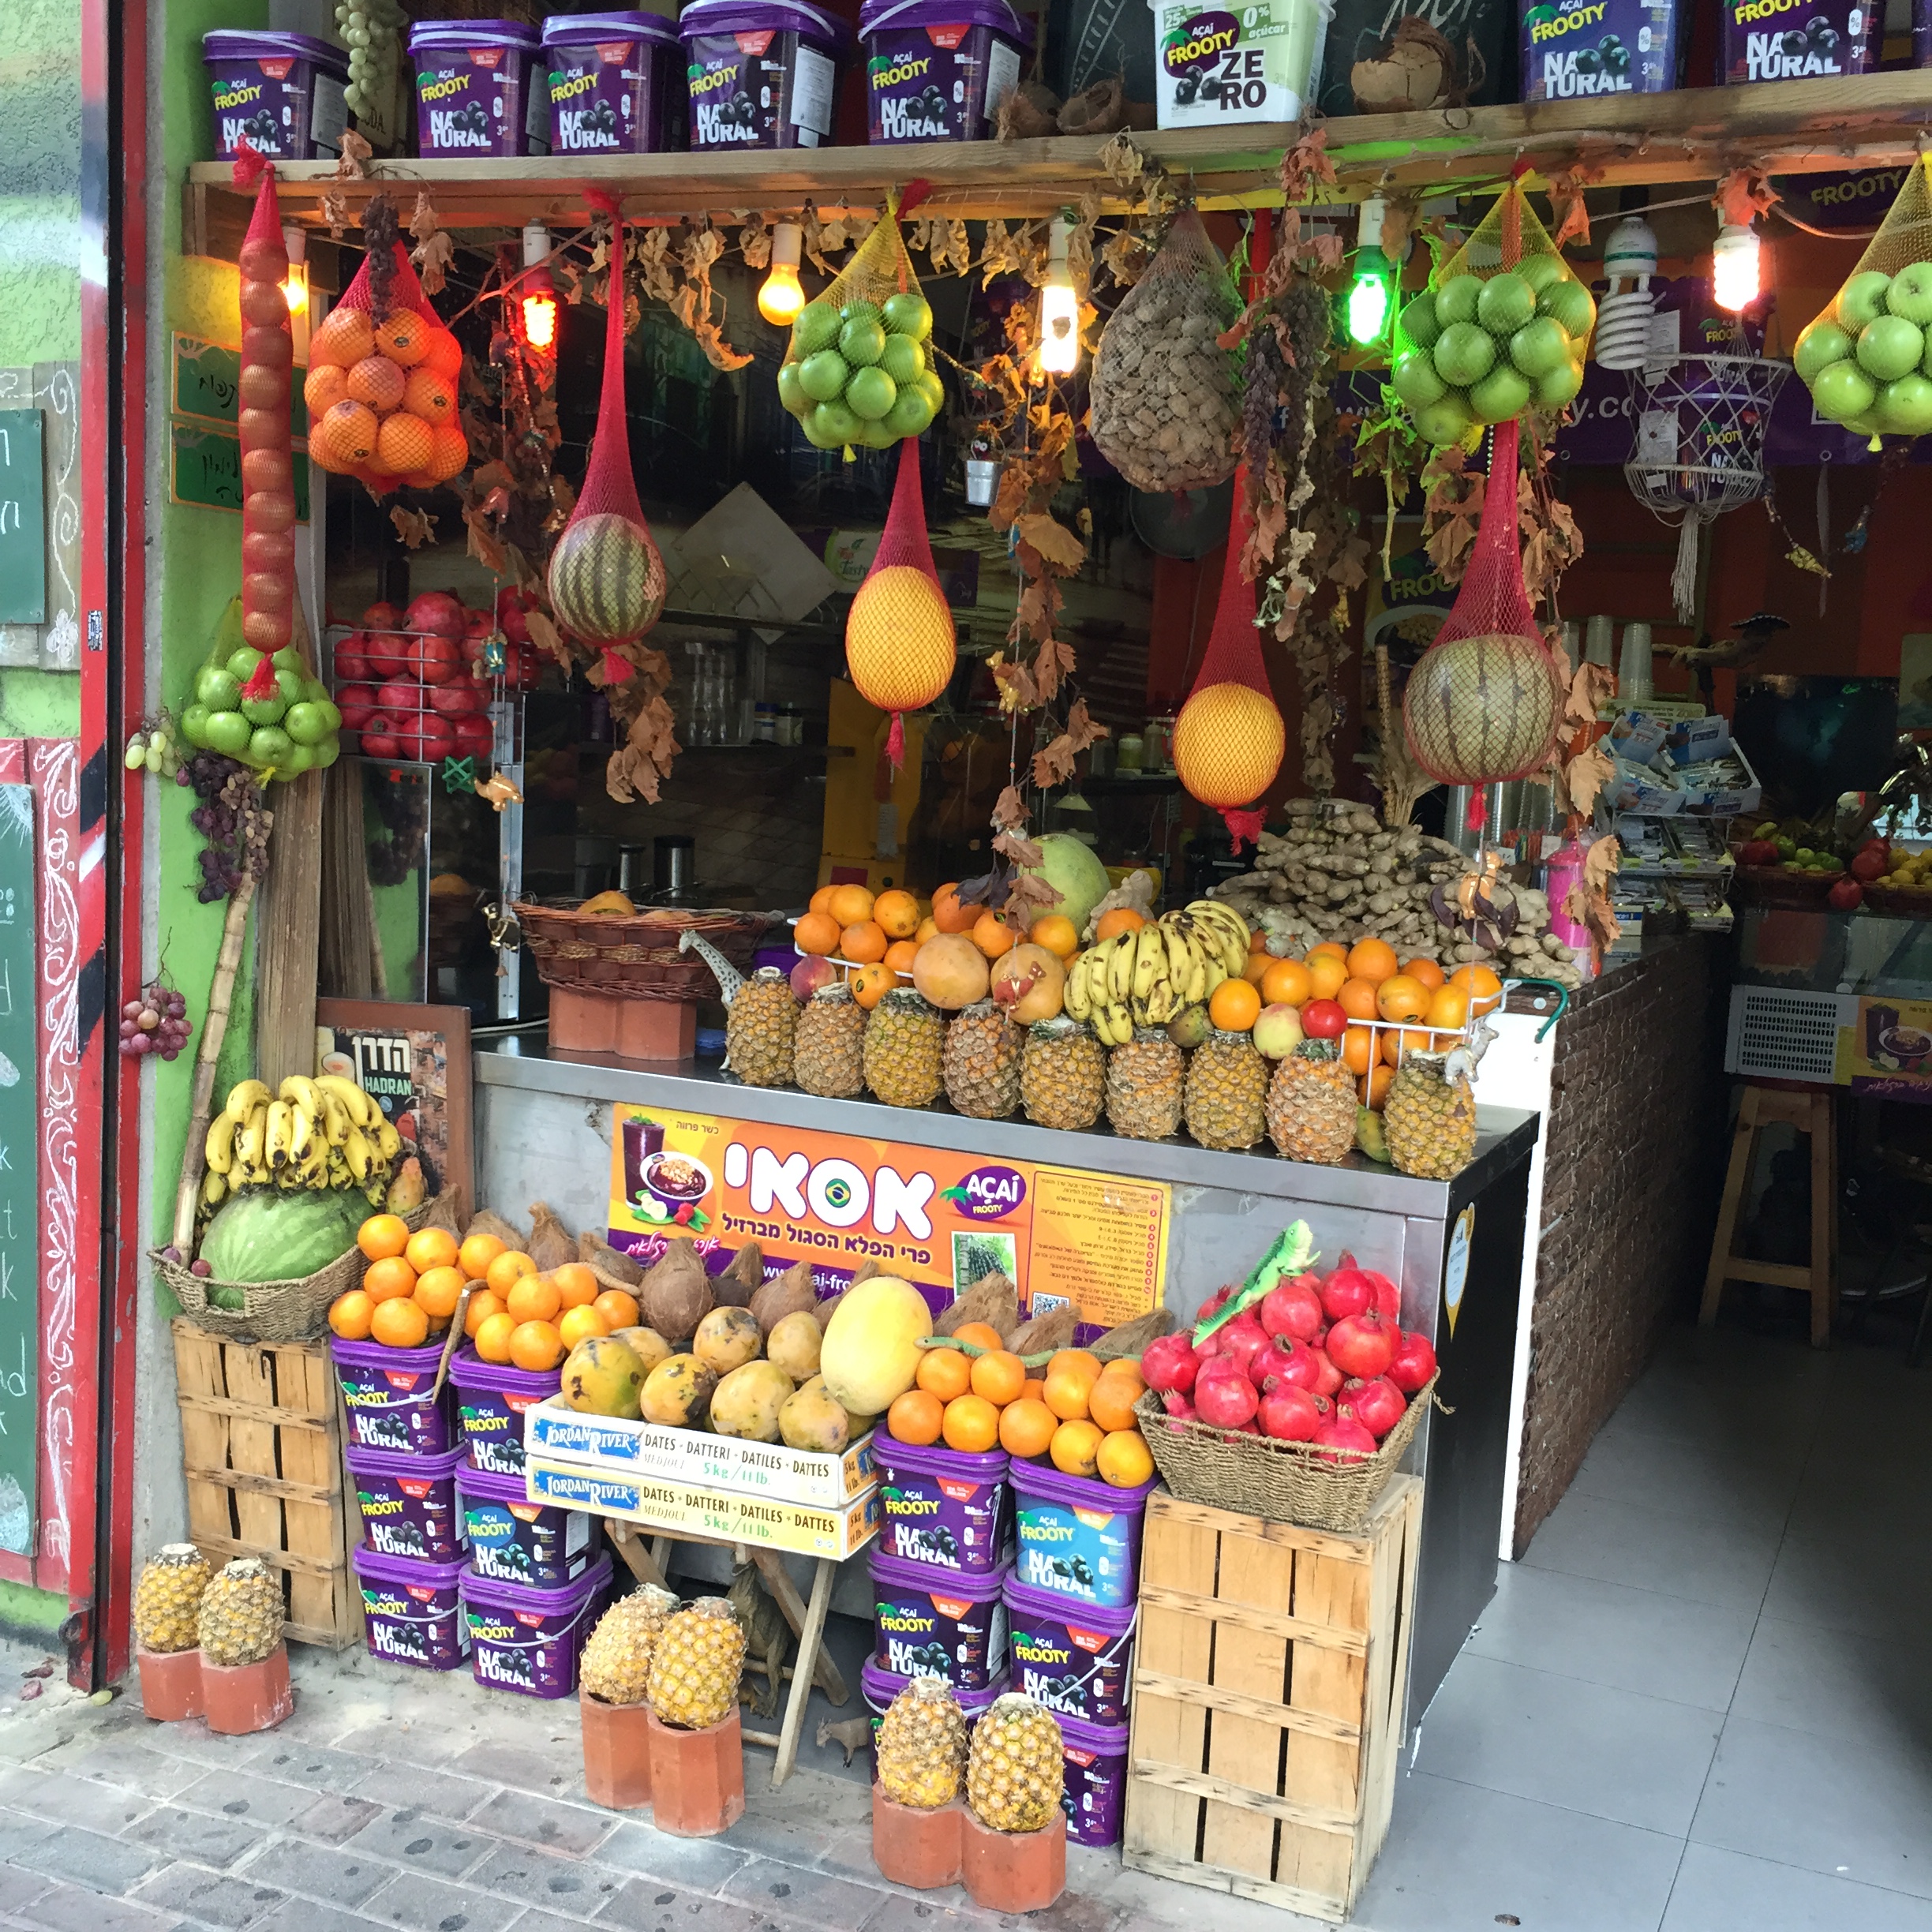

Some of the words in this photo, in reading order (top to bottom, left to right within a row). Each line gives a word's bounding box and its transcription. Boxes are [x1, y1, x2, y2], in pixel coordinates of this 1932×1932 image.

[1192, 22, 1214, 38] AÇAÍ
[1249, 24, 1286, 39] açúcar
[1531, 2, 1607, 43] FROOTY
[893, 51, 912, 65] AÇAÍ
[1167, 29, 1234, 66] FROOTY
[1747, 32, 1784, 63] NA
[438, 69, 455, 79] AÇAÍ
[567, 67, 583, 79] AÇAÍ
[706, 59, 722, 72] AÇAÍ
[872, 58, 930, 90] FROOTY
[1222, 50, 1264, 80] ZE
[1544, 51, 1578, 80] NA
[1749, 54, 1841, 80] TURAL
[231, 78, 247, 91] AÇAÍ
[421, 74, 470, 103] FROOTY
[551, 73, 598, 103] FROOTY
[690, 65, 739, 97] FROOTY
[1544, 73, 1632, 98] TURAL
[215, 85, 261, 110] FROOTY
[1221, 80, 1267, 110] RO
[697, 103, 721, 129] NA
[881, 97, 908, 124] NA
[431, 110, 452, 133] NA
[560, 110, 582, 136] NA
[883, 117, 949, 139] TURAL
[432, 130, 492, 148] TURAL
[560, 130, 620, 149] TURAL
[698, 122, 758, 144] TURAL
[1811, 169, 1904, 205] FROOTY
[352, 1036, 410, 1090] הדרן
[365, 1076, 412, 1095] HADRAN
[676, 1121, 698, 1131] פרווה
[701, 1125, 719, 1135] כשר
[724, 1142, 936, 1241] אסאי
[966, 1174, 1020, 1204] AÇAÍ
[972, 1204, 1003, 1214] FROOTY
[722, 1213, 781, 1238] מברזיל
[787, 1223, 839, 1249] הסגול
[845, 1235, 894, 1258] הפלא
[900, 1246, 930, 1264] פרי
[360, 1383, 374, 1392] AÇAÍ
[346, 1391, 388, 1406] FROOTY
[355, 1413, 378, 1432] NA
[478, 1409, 493, 1417] AÇAÍ
[463, 1417, 508, 1432] FROOTY
[360, 1429, 414, 1451] TURAL
[473, 1439, 494, 1457] NA
[544, 1425, 590, 1447] JORDAN
[589, 1430, 632, 1458] RIVER
[645, 1434, 676, 1451] DATES
[687, 1440, 731, 1461] DATTERI
[742, 1451, 782, 1470] DATILES
[793, 1460, 829, 1477] DATTES
[375, 1493, 389, 1502] AÇAÍ
[545, 1476, 590, 1498] JORDAN
[589, 1482, 632, 1507] RIVER
[904, 1490, 923, 1500] AÇAÍ
[361, 1500, 403, 1515] FROOTY
[643, 1486, 675, 1503] DATES
[686, 1494, 729, 1513] DATTERI
[741, 1503, 783, 1523] DATILES
[795, 1514, 834, 1533] DATTES
[886, 1501, 938, 1515] FROOTY
[371, 1522, 393, 1540] NA
[468, 1523, 512, 1537] FROOTY
[1039, 1516, 1057, 1526] AÇAÍ
[895, 1522, 919, 1544] NA
[1020, 1526, 1073, 1541] FROOTY
[374, 1539, 429, 1557] TURAL
[476, 1543, 496, 1563] NA
[897, 1541, 961, 1568] TURAL
[1029, 1548, 1054, 1572] NA
[478, 1560, 534, 1582] TURAL
[1031, 1570, 1095, 1598] TURAL
[365, 1601, 407, 1614] FROOTY
[380, 1593, 395, 1601] AÇAÍ
[485, 1617, 500, 1626] AÇAÍ
[900, 1607, 917, 1617] AÇAÍ
[373, 1620, 394, 1640] NA
[470, 1627, 515, 1639] FROOTY
[881, 1617, 933, 1632] FROOTY
[376, 1638, 429, 1661] TURAL
[889, 1638, 914, 1660] NA
[1035, 1638, 1052, 1649] AÇAÍ
[478, 1646, 500, 1667] NA
[1016, 1646, 1069, 1664] FROOTY
[481, 1664, 536, 1688] TURAL
[1024, 1667, 1049, 1691] NA
